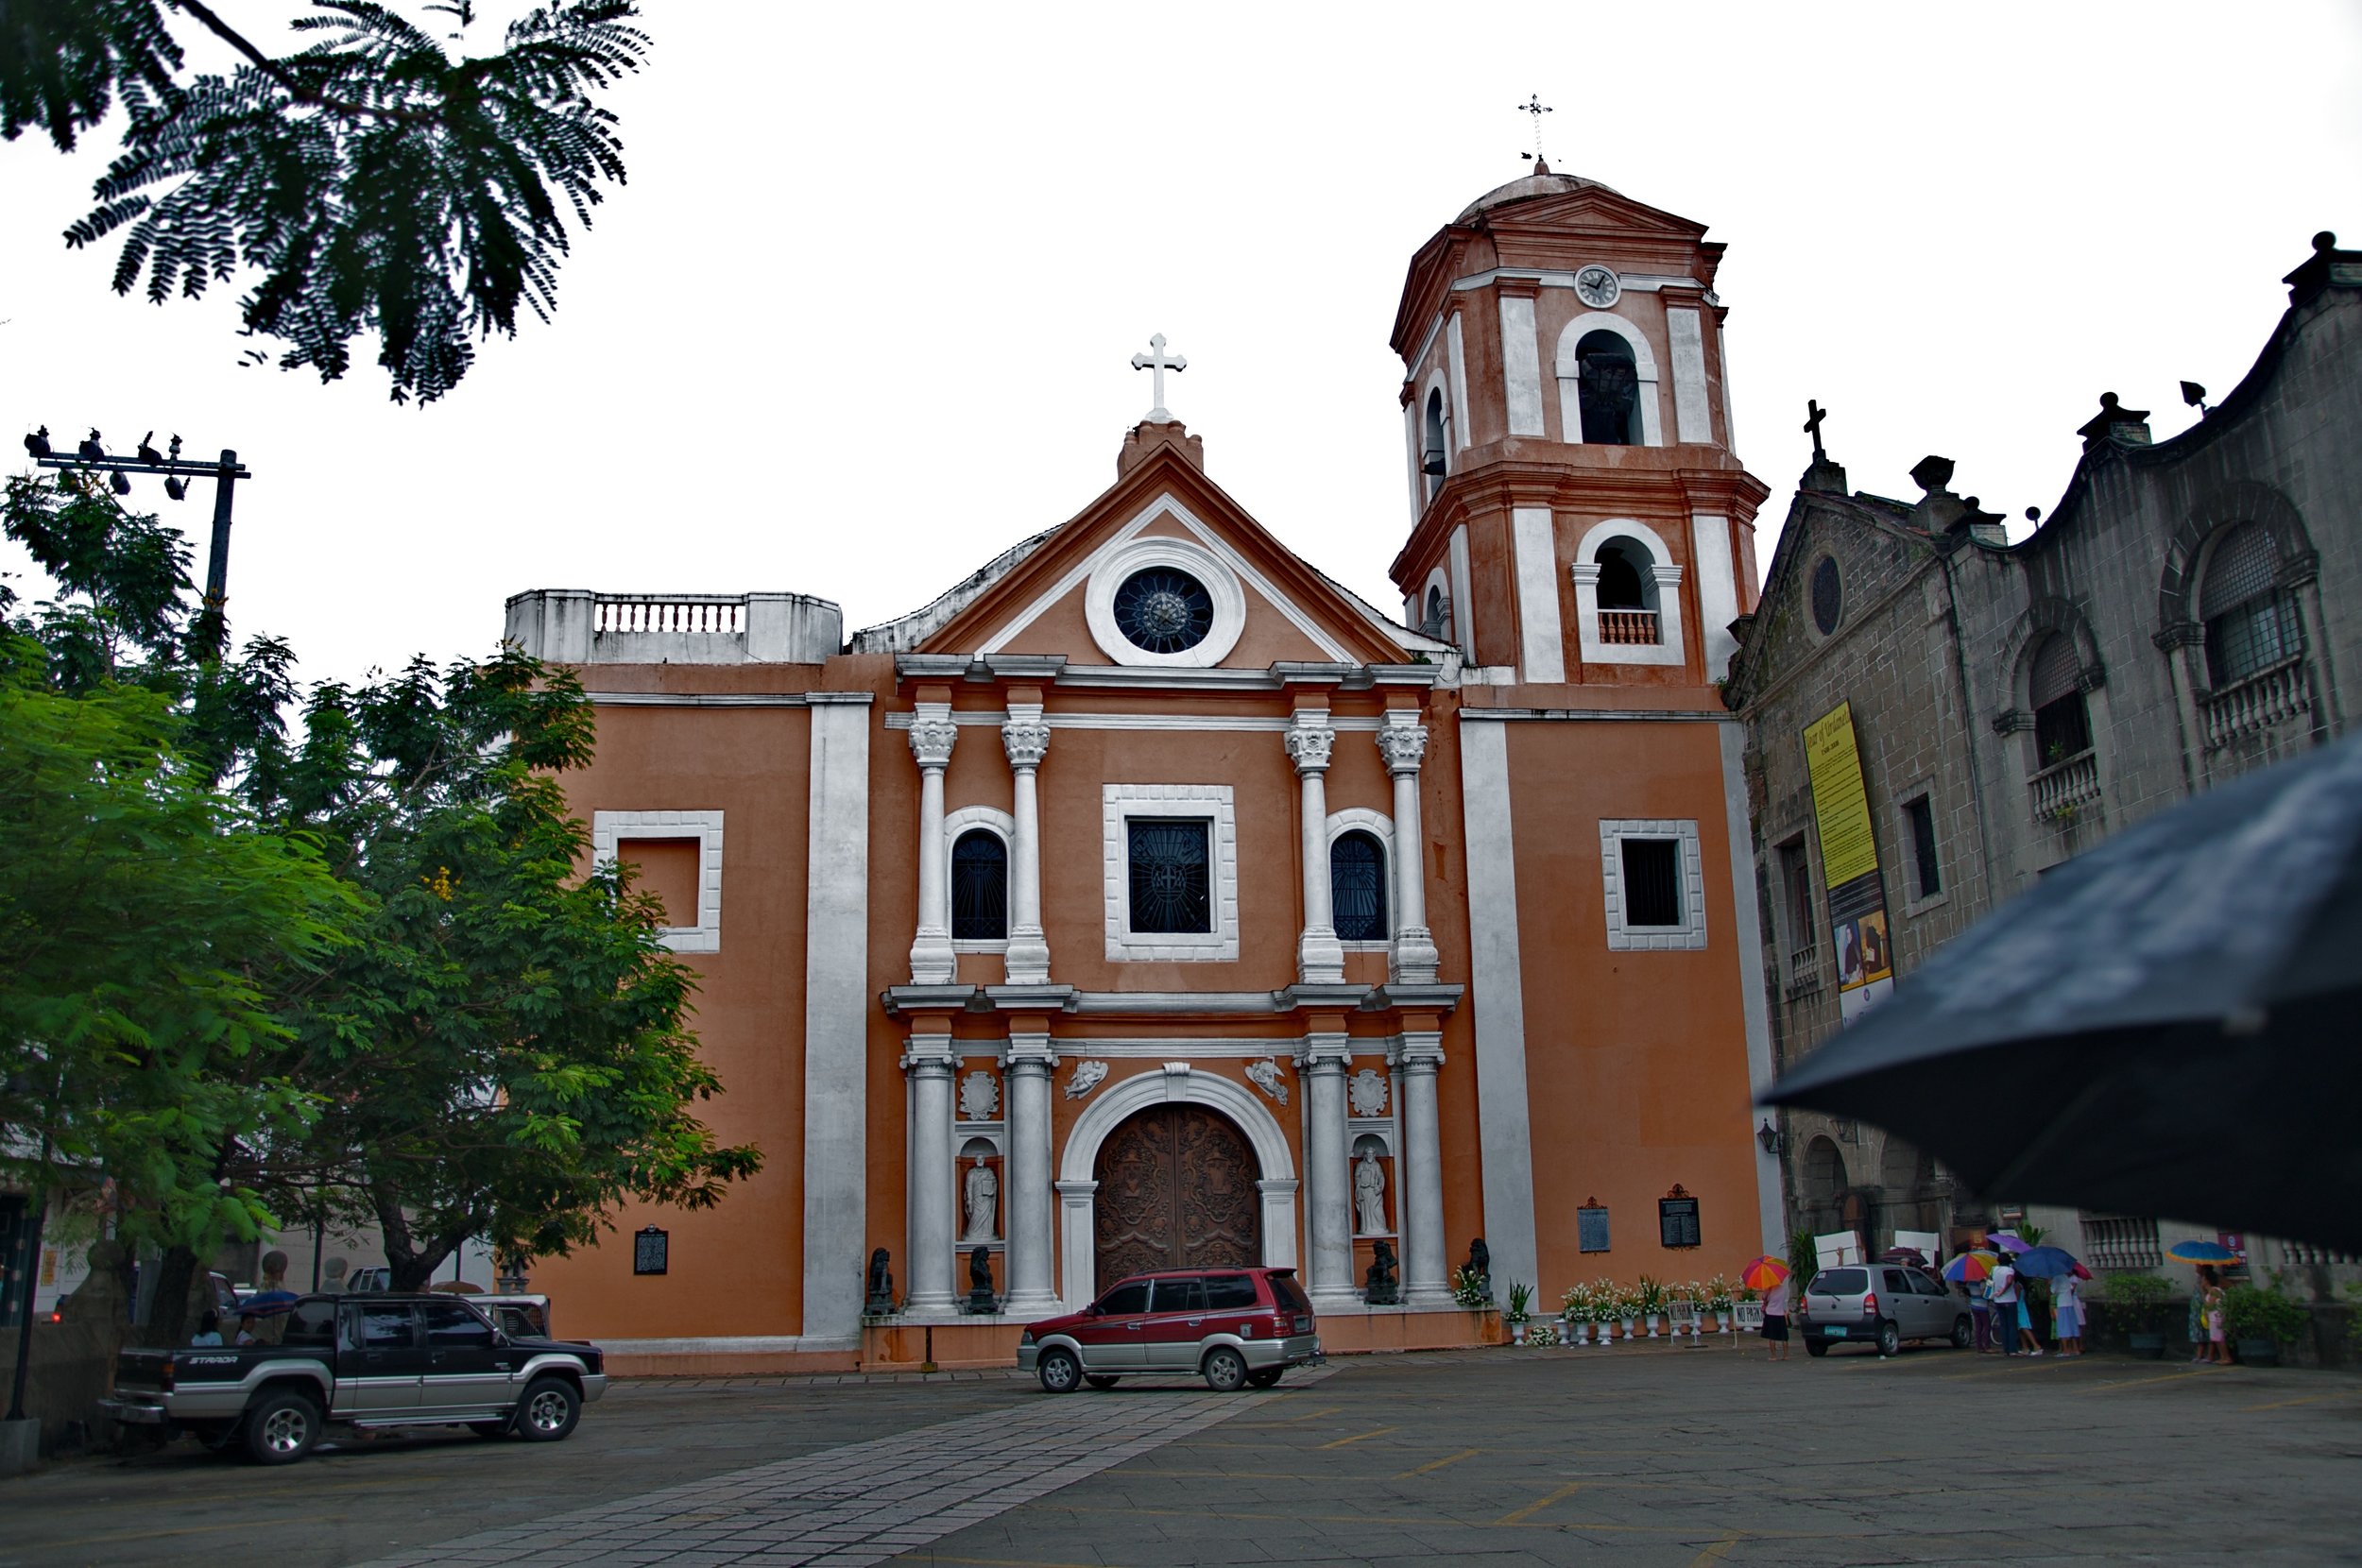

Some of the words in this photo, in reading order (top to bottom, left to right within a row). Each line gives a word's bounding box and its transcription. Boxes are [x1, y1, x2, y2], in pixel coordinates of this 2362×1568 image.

[1669, 1304, 1677, 1321] NO
[1737, 1306, 1746, 1322] NO
[189, 1356, 238, 1365] STRADA
